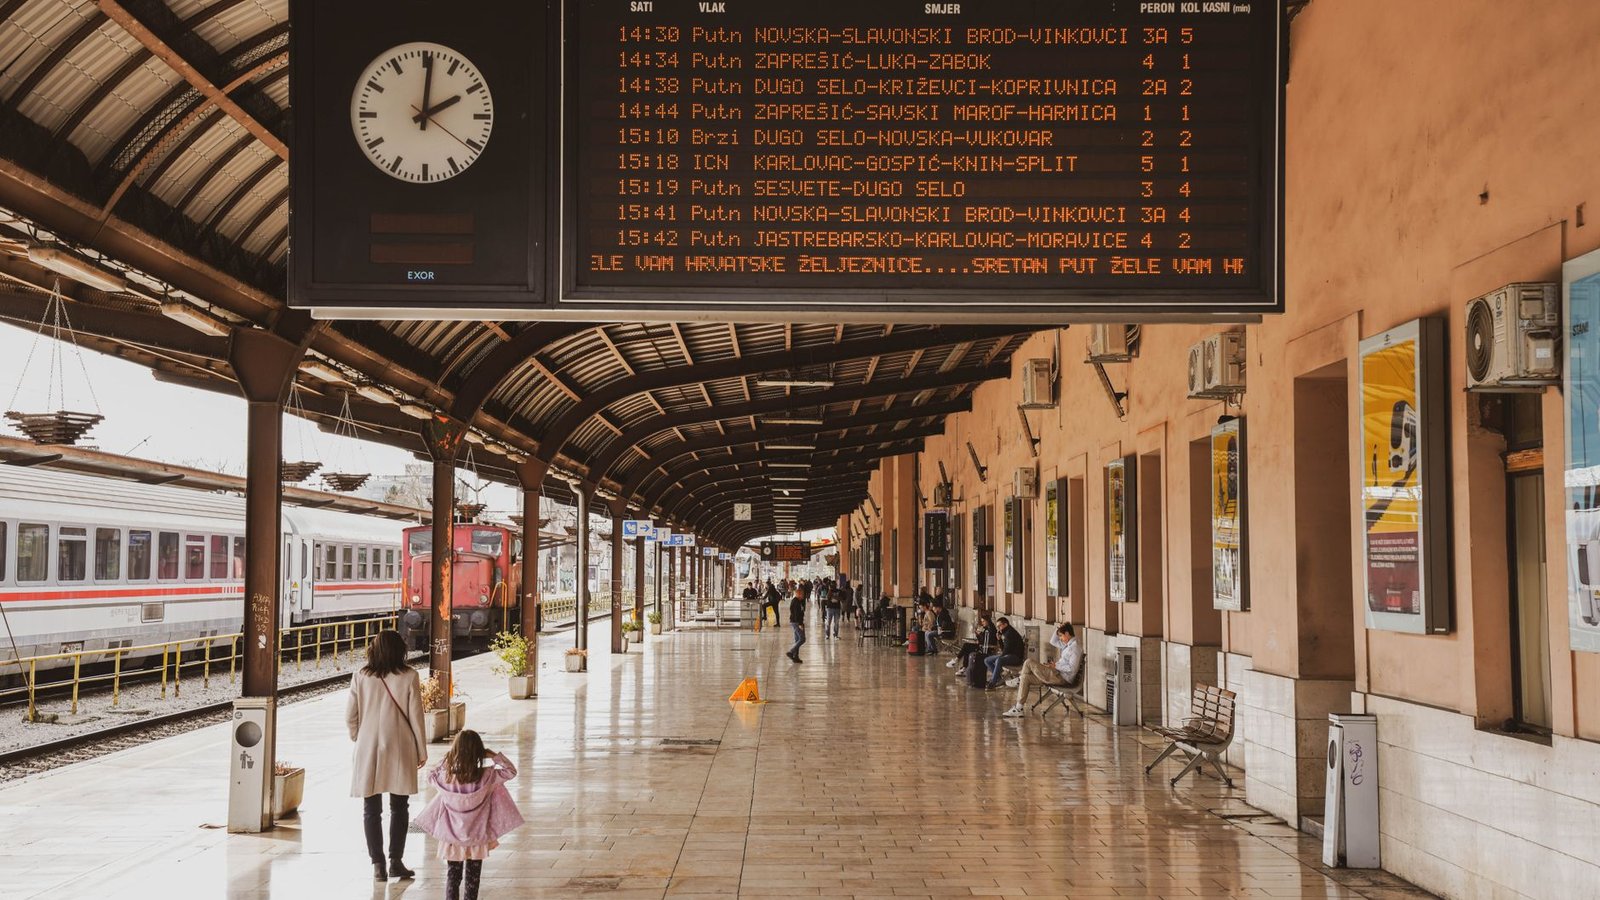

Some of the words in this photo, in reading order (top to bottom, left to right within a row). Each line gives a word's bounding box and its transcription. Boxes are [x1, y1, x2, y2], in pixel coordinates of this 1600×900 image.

[630, 1, 653, 12] SATI
[698, 2, 726, 13] VLAK
[924, 3, 961, 14] SMJER
[1140, 2, 1175, 13] PERON
[1180, 2, 1200, 13] KOL
[1202, 2, 1230, 13] KASNI
[1232, 4, 1251, 14] (min)
[619, 26, 680, 42] 14:30
[692, 27, 742, 42] Putn
[755, 28, 952, 43] NOVSKA-SLAVONSKI
[967, 28, 1128, 44] BROD-VINKOVCI
[1143, 28, 1168, 43] 3A
[1180, 28, 1193, 43] 5
[619, 52, 680, 67] 14:34
[692, 53, 742, 68] Putn
[755, 52, 991, 69] ZAPREŠIĆ-LUKA-ZABOK
[1142, 54, 1155, 69] 4
[1182, 54, 1191, 69] 1
[619, 78, 680, 93] 14:38
[692, 78, 742, 93] Putn
[754, 79, 804, 94] DUGO
[816, 78, 1117, 95] SELO-KRIŽEVCI-KOPRIVNICA
[1142, 80, 1167, 95] 2A
[1180, 79, 1193, 95] 2
[619, 103, 679, 118] 14:44
[692, 104, 742, 119] Putn
[754, 103, 939, 120] ZAPREŠIĆ-SAVSKI
[953, 105, 1117, 120] MAROF-HARMICA
[1143, 105, 1152, 120] 1
[1182, 105, 1190, 120] 1
[619, 128, 679, 144] 15:10
[692, 129, 739, 144] Brzi
[754, 130, 804, 145] DUGO
[816, 130, 1053, 146] SELO-NOVSKA-VUKOVAR
[1141, 131, 1154, 146] 2
[1179, 131, 1192, 146] 2
[619, 154, 679, 169] 15:18
[693, 155, 729, 170] ICN
[753, 154, 1078, 172] KARLOVAC-GOSPIĆ-KNIN-SPLIT
[1141, 156, 1154, 172] 5
[1181, 156, 1189, 171] 1
[618, 179, 679, 195] 15:19
[691, 180, 741, 195] Putn
[753, 181, 903, 196] SESVETE-DUGO
[915, 181, 966, 197] SELO
[1140, 182, 1154, 197] 3
[1179, 182, 1192, 197] 4
[618, 205, 676, 220] 15:41
[691, 205, 741, 221] Putn
[753, 206, 951, 222] NOVSKA-SLAVONSKI
[964, 207, 1126, 223] BROD-VINKOVCI
[1140, 207, 1167, 223] 3A
[1178, 208, 1191, 223] 4
[618, 230, 678, 245] 15:42
[691, 231, 741, 246] Putn
[753, 231, 1128, 248] JASTREBARSKO-KARLOVAC-MORAVICE
[1140, 233, 1153, 248] 4
[1178, 233, 1191, 248] 2
[635, 256, 674, 271] VAM
[684, 256, 786, 272] HRVATSKE
[1058, 258, 1099, 273] PUT
[1109, 256, 1161, 274] ŽELE
[1172, 258, 1213, 274] VAM
[1222, 258, 1244, 274] HR
[407, 271, 435, 280] EXOR
